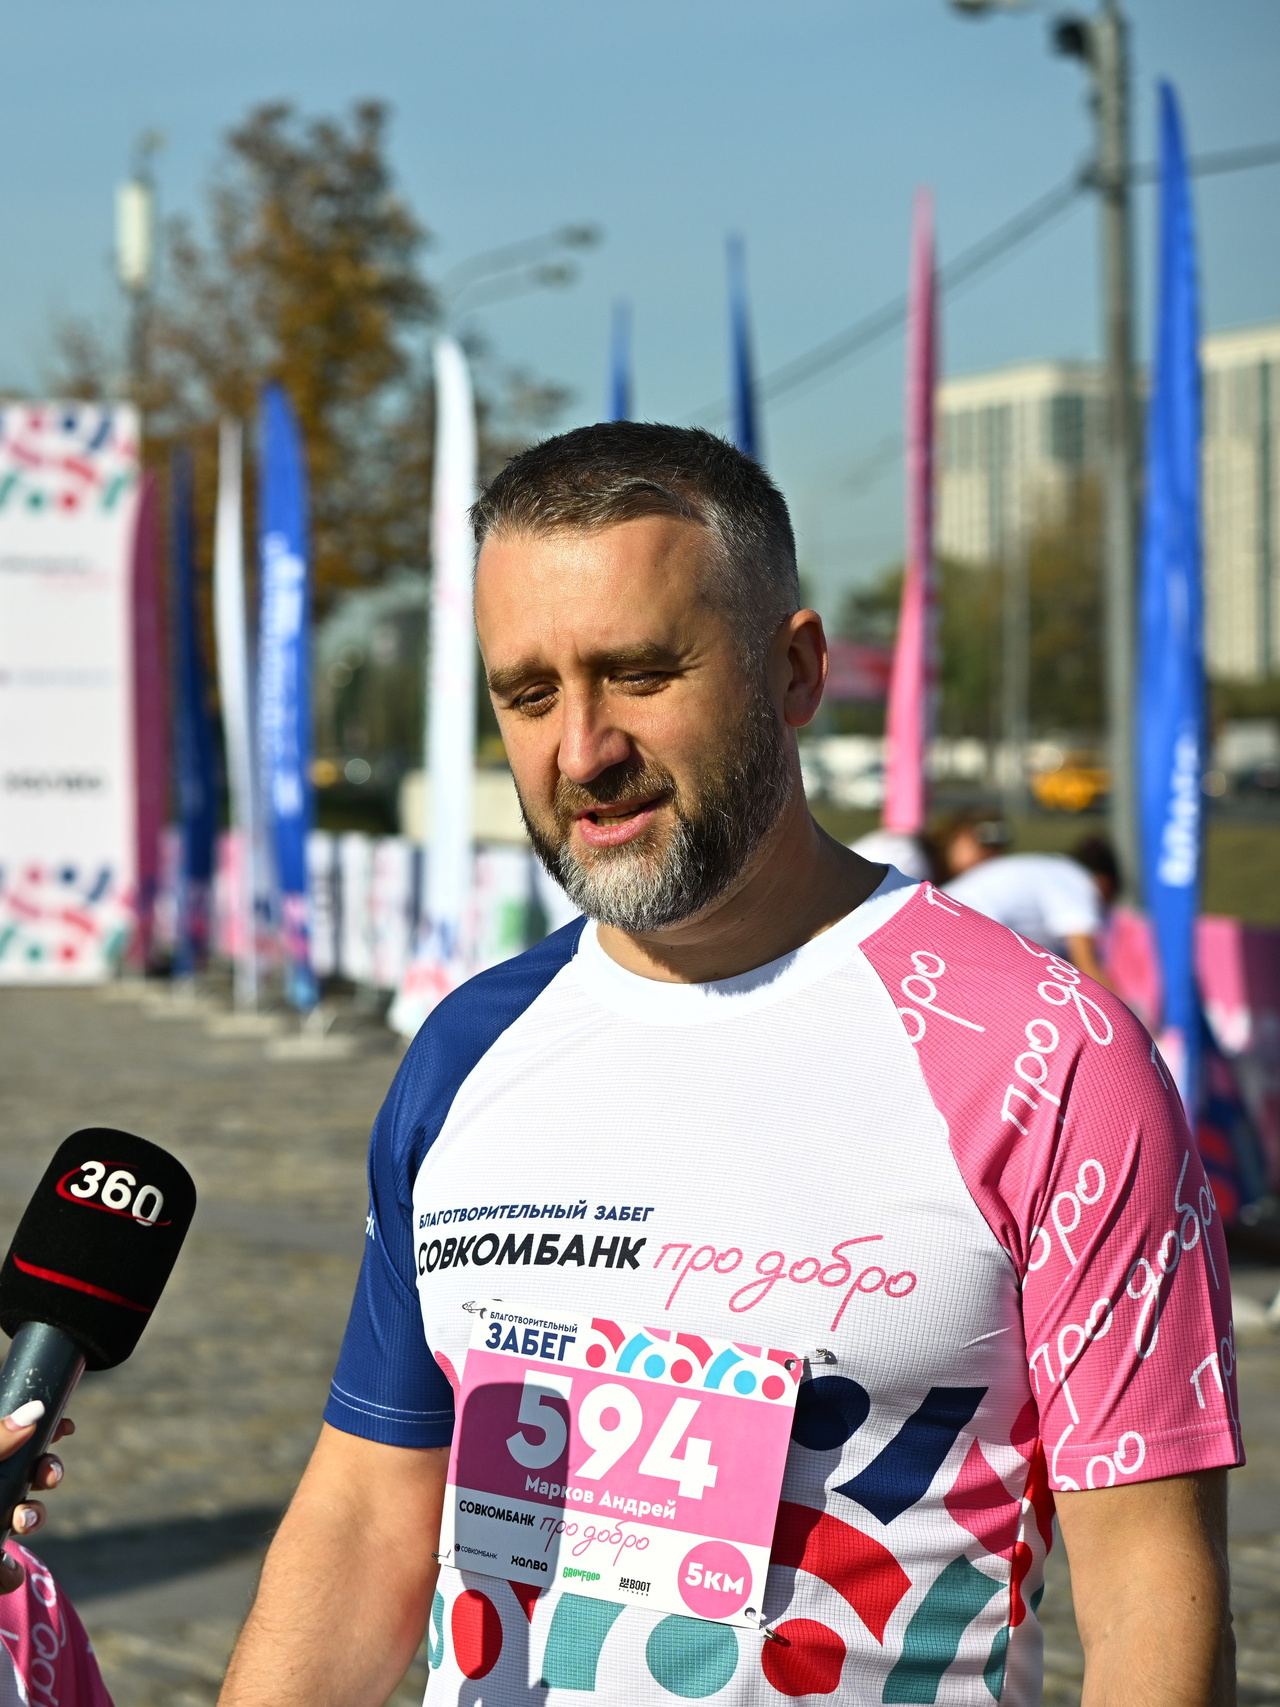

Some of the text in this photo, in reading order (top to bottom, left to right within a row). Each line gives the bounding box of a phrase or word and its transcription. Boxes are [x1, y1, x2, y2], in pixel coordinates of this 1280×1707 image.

[1001, 1018, 1065, 1136] про
[70, 1160, 164, 1227] 360
[419, 1200, 655, 1229] БЛАГОТВОРИТЕЛЬНЫЙ ЗАБЕГ
[418, 1233, 917, 1332] СОВКОМБАНК про добро
[485, 1322, 577, 1362] ЗАБЕГ
[490, 1311, 579, 1334] БЛАГОТВОРИТЕЛЬНЫЙ
[1029, 1298, 1113, 1424] про
[505, 1369, 719, 1500] 594
[524, 1474, 677, 1520] Марков Андрей
[458, 1499, 650, 1567] СОВКОМБАНК про добро
[460, 1545, 498, 1560] СОВКОМБАНК
